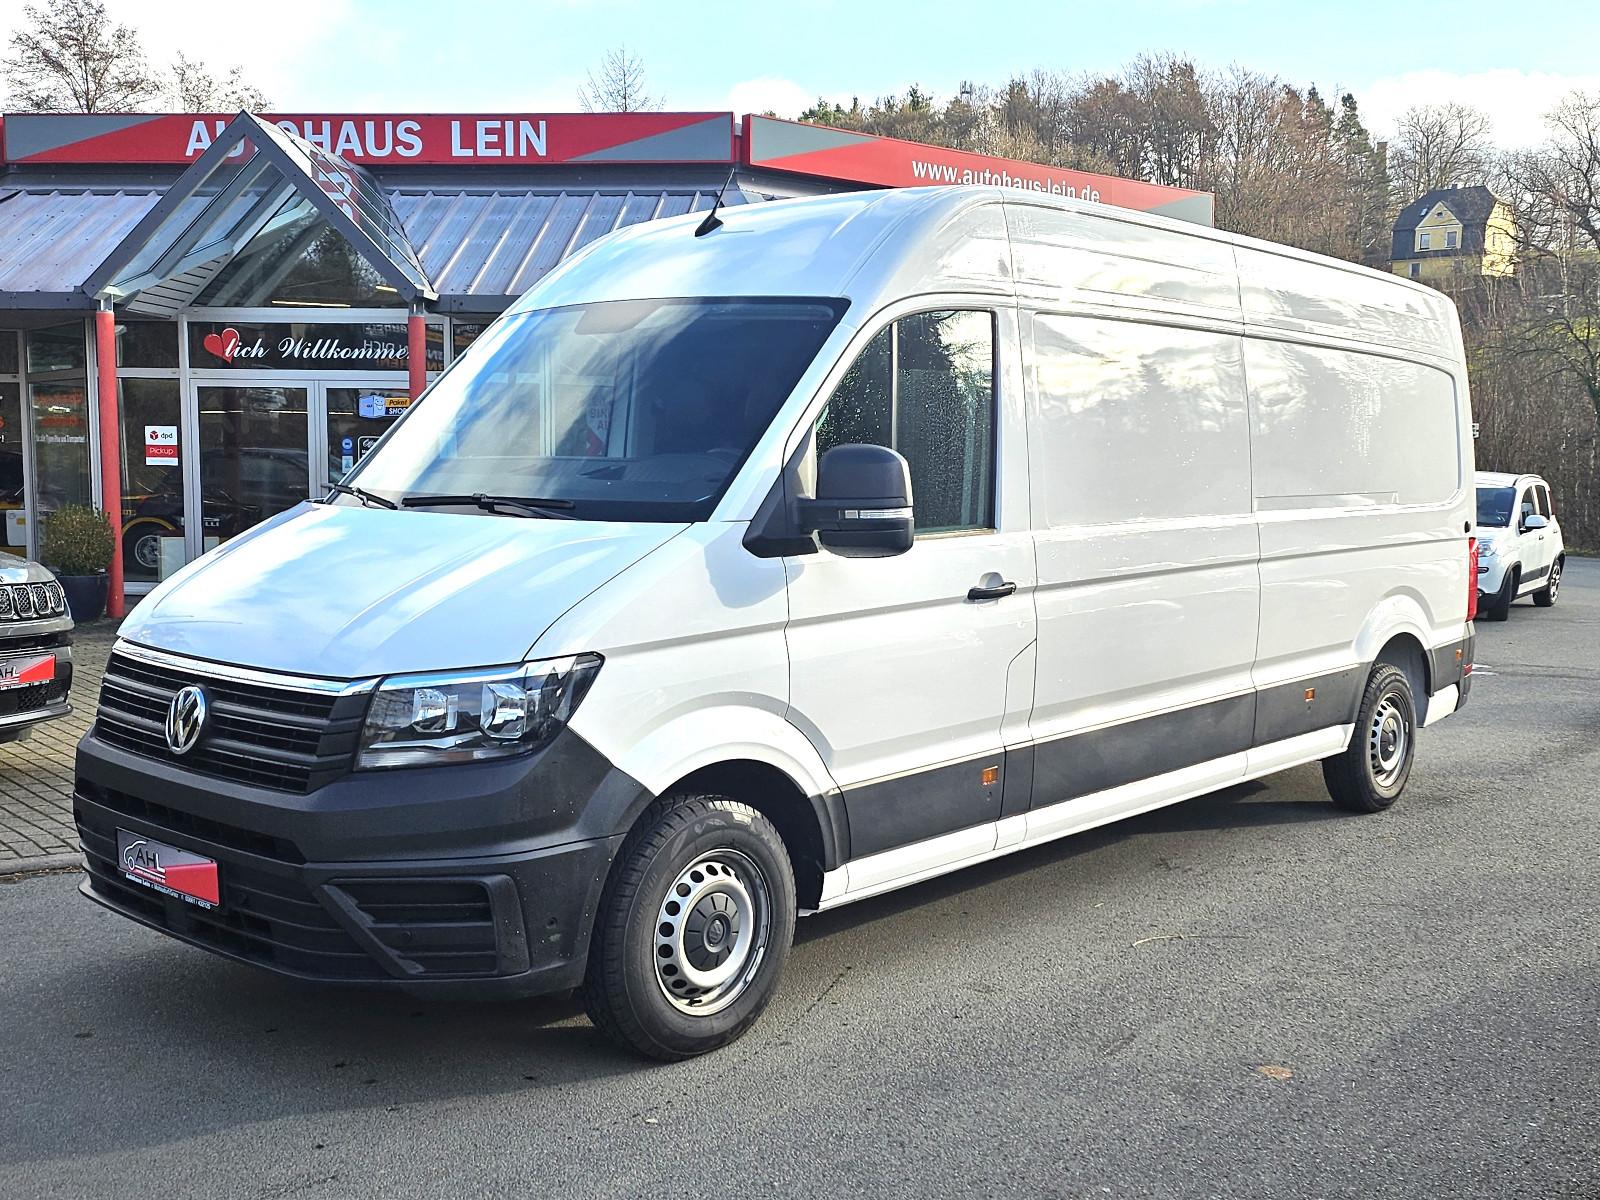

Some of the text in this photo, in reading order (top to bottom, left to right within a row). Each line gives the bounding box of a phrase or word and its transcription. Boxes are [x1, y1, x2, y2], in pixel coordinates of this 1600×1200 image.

[185, 120, 547, 158] AUHAUS LEIN
[224, 337, 269, 359] lich
[278, 337, 410, 359] Willkomme
[160, 432, 173, 440] dpd
[149, 447, 174, 456] Pickup
[135, 846, 166, 873] AHL
